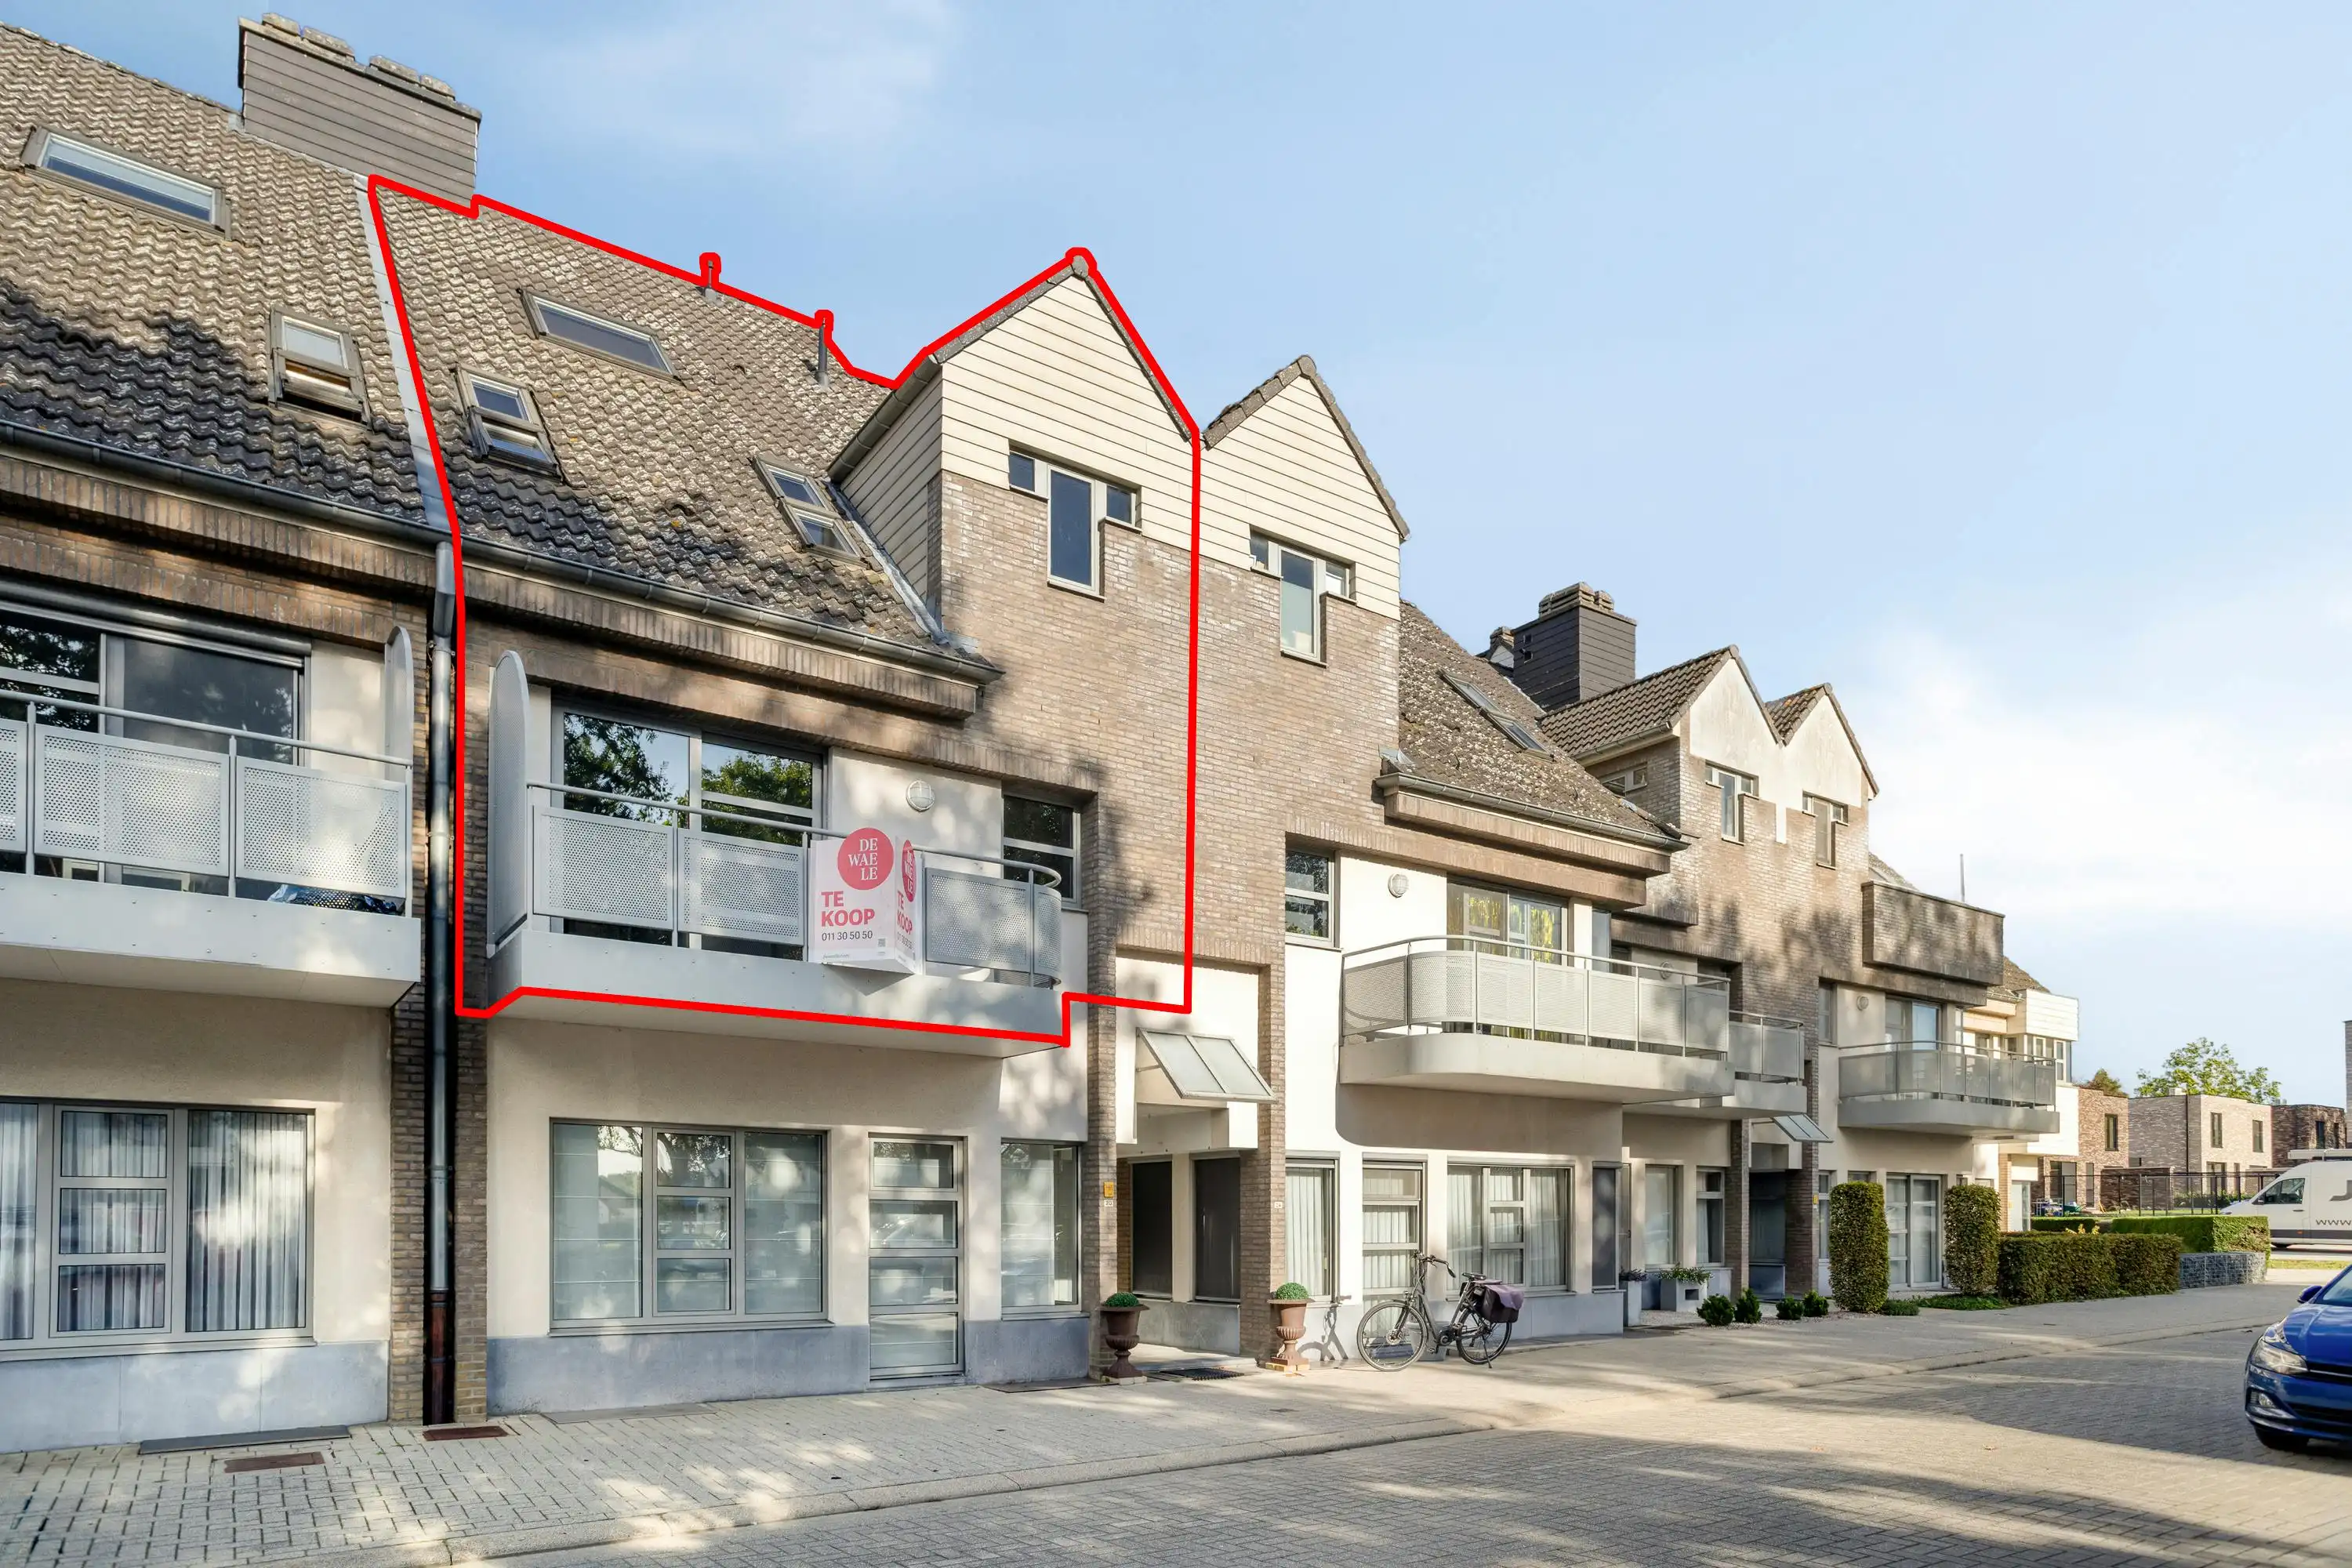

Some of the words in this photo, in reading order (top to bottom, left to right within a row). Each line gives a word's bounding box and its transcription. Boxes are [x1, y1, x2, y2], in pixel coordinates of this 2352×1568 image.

[859, 838, 878, 852] DE
[848, 852, 878, 866] WAE
[861, 867, 878, 880] LE
[821, 891, 844, 907] TE
[898, 890, 904, 910] TE
[821, 909, 875, 927] KOOP
[898, 909, 913, 935] KOOP
[822, 932, 835, 941] 011
[837, 931, 848, 941] 30
[849, 931, 860, 940] 50
[862, 930, 873, 939] 50
